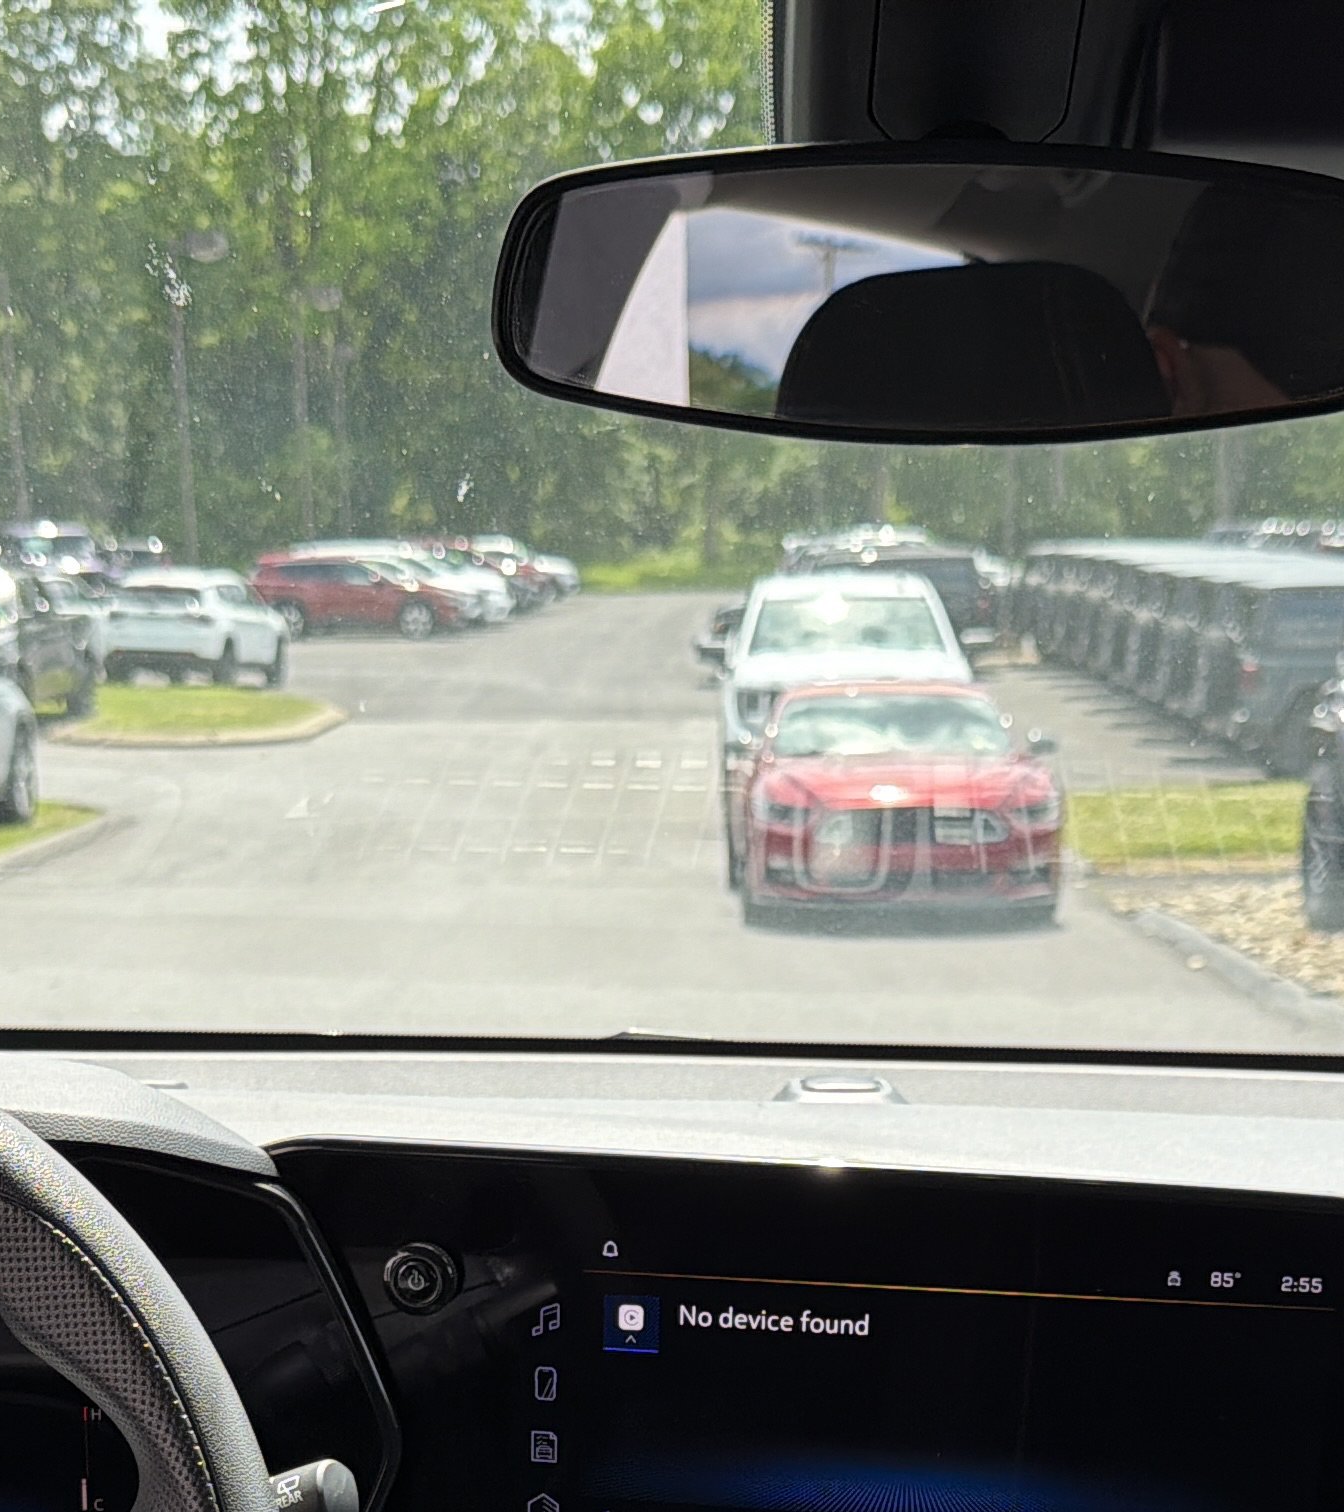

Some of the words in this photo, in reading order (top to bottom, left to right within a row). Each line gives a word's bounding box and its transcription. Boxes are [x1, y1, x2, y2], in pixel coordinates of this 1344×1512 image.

[1280, 1276, 1323, 1294] 2:55
[679, 1305, 713, 1329] No
[719, 1306, 794, 1333] device
[800, 1310, 870, 1337] found
[91, 1408, 102, 1421] H
[93, 1498, 104, 1512] C
